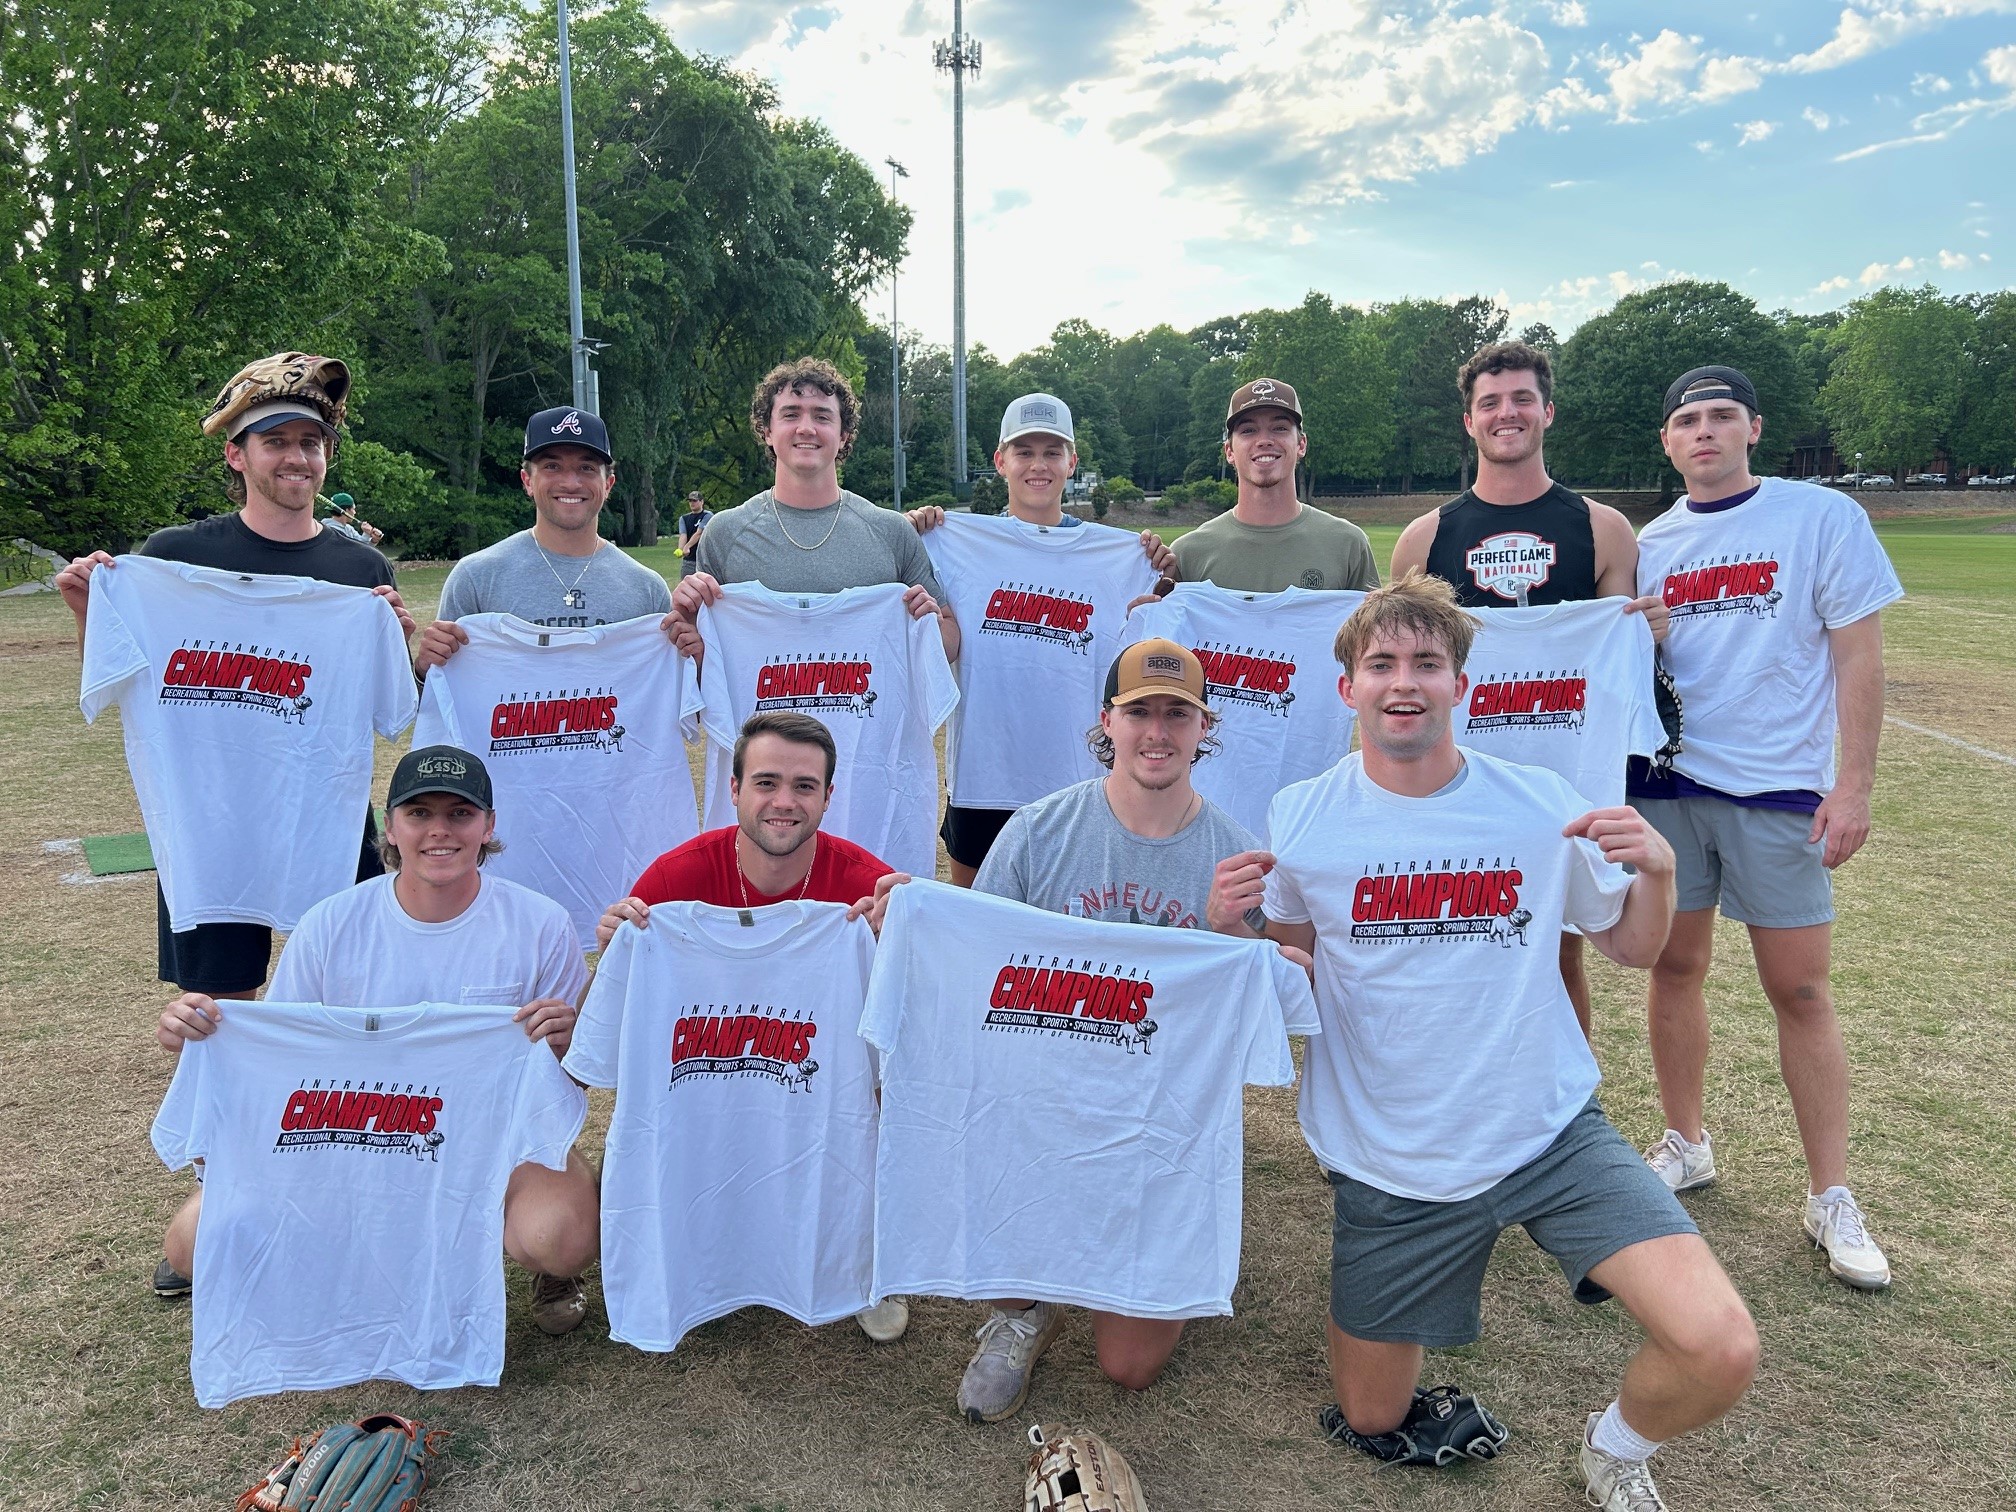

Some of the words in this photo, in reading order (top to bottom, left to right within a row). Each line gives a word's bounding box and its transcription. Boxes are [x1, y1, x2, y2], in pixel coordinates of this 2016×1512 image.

[551, 411, 582, 435] A
[1471, 550, 1517, 565] PERFECT
[1520, 548, 1551, 561] GAME
[1670, 552, 1774, 574] INTRAMURAL
[1484, 563, 1538, 578] NATIONAL
[1000, 581, 1092, 603] INTRAMURAL
[1662, 561, 1778, 608] CHAMPIONS
[986, 589, 1094, 633] CHAMPIONS
[1735, 599, 1750, 608] 2024
[1717, 609, 1748, 617] GEORGIA
[979, 630, 1020, 639] UNIVERSITY
[1036, 637, 1065, 646] GEORGIA
[985, 621, 1017, 631] RECREATIONAL
[1019, 624, 1037, 633] SPORTS
[1040, 628, 1056, 637] SPRING
[1056, 631, 1068, 639] 2024
[182, 639, 310, 663] INTRAMURAL
[766, 653, 867, 664] INTRAMURAL
[1196, 640, 1294, 662] INTRAMURAL
[164, 649, 312, 698] CHAMPIONS
[757, 662, 872, 699] CHAMPIONS
[164, 689, 209, 699] RECREATIONAL
[212, 691, 236, 700] SPORTS
[241, 693, 263, 704] SPRING
[263, 697, 279, 707] 2024
[501, 687, 613, 702] INTRAMURAL
[1212, 687, 1232, 696] SPORTS
[1235, 690, 1253, 699] SPRING
[1253, 693, 1267, 702] 2024
[1232, 699, 1263, 708] GEORGIA
[1469, 678, 1586, 717] CHAMPIONS
[238, 703, 275, 715] GEORGIA
[759, 701, 794, 710] RECREATIONAL
[819, 698, 837, 706] SPRING
[491, 696, 617, 738] CHAMPIONS
[1471, 717, 1507, 728] RECREATIONAL
[1535, 715, 1553, 723] SPRING
[1554, 714, 1568, 722] 2024
[1465, 726, 1513, 735] UNIVERSITY
[494, 740, 532, 749] RECREATIONAL
[535, 738, 556, 746] SPORTS
[561, 736, 580, 744] SPRING
[581, 734, 596, 742] 2024
[488, 749, 538, 757] UNIVERSITY
[434, 762, 451, 772] 4S
[1365, 857, 1517, 875] INTRAMURAL
[1352, 870, 1523, 922] CHAMPIONS
[1355, 924, 1405, 936] RECREATIONAL
[1408, 923, 1436, 934] SPORTS
[1442, 922, 1469, 933] SPRING
[1470, 921, 1490, 931] 2024
[1009, 953, 1150, 980] INTRAMURAL
[990, 965, 1153, 1024] CHAMPIONS
[681, 1004, 813, 1021] INTRAMURAL
[990, 1013, 1039, 1025] RECREATIONAL
[1041, 1017, 1068, 1028] SPORTS
[1073, 1021, 1099, 1033] SPRING
[1099, 1024, 1118, 1035] 2024
[672, 1016, 816, 1065] CHAMPIONS
[981, 1024, 1044, 1036] UNIVERSITY
[1070, 1033, 1115, 1044] GEORGIA
[673, 1061, 711, 1078] RECREATIONAL
[714, 1060, 738, 1071] SPORTS
[744, 1059, 767, 1070] SPRING
[767, 1062, 783, 1073] 2024
[300, 1079, 440, 1096] INTRAMURAL
[669, 1073, 716, 1091] UNIVERSITY
[741, 1071, 780, 1083] GEORGIA
[281, 1090, 443, 1135] CHAMPIONS
[282, 1133, 331, 1144] RECREATIONAL
[335, 1133, 360, 1142] SPORTS
[366, 1135, 389, 1145] SPRING
[390, 1137, 408, 1145] 2024
[273, 1144, 337, 1153] UNIVERSITY
[362, 1146, 405, 1155] GEORGIA
[298, 1444, 330, 1488] A2000
[1085, 1440, 1105, 1492] EASTON
